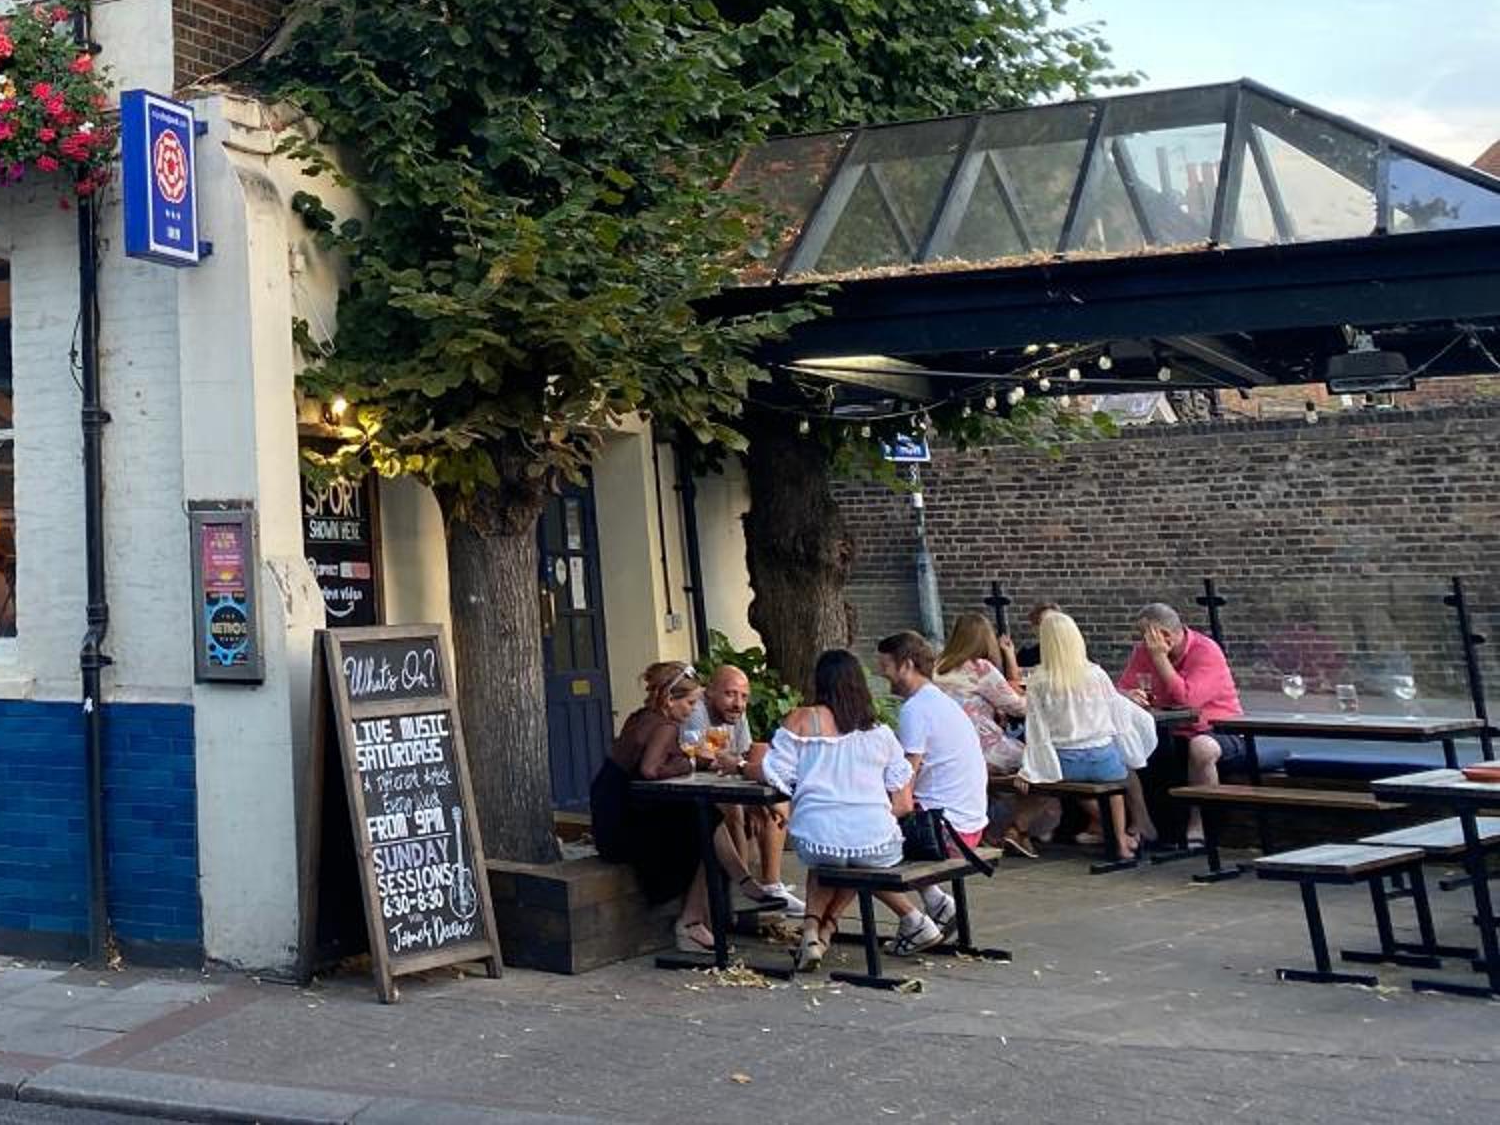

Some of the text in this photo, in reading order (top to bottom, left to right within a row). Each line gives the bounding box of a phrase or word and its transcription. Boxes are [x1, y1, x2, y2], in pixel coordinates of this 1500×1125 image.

[304, 477, 362, 517] SPORT
[308, 519, 361, 540] SHOWN HERE
[344, 648, 435, 696] What's On?
[352, 714, 449, 745] LIVE MUSIC
[355, 738, 444, 772] SATURDAYS
[366, 806, 446, 843] FROM 9PM
[373, 837, 450, 874] SUNDAY
[377, 861, 454, 898] SESSIONS
